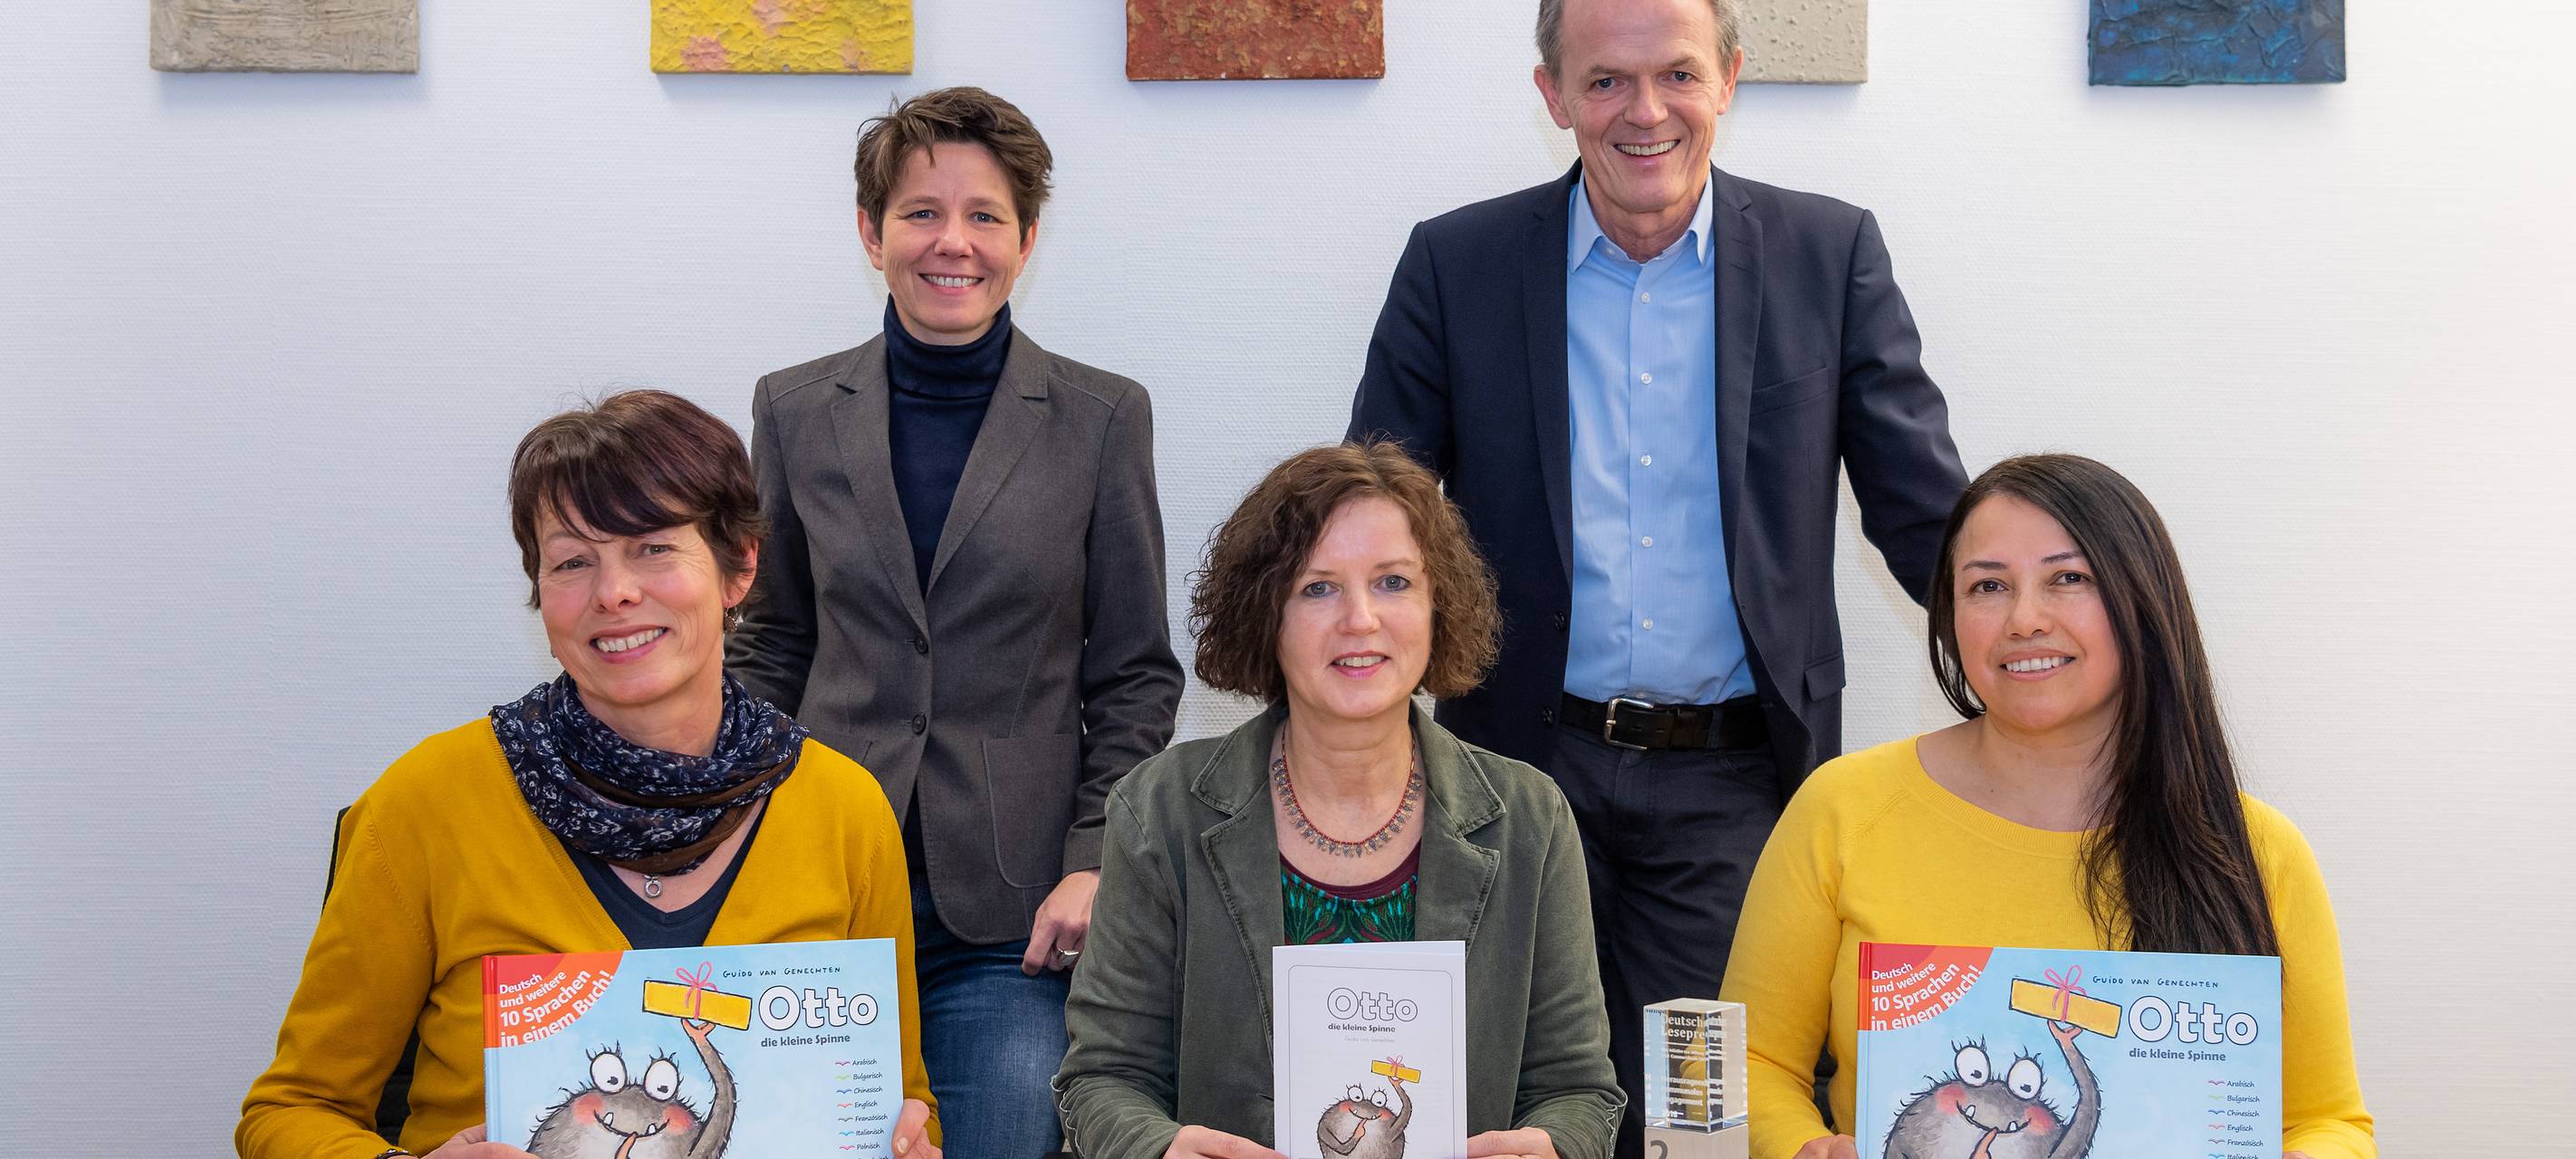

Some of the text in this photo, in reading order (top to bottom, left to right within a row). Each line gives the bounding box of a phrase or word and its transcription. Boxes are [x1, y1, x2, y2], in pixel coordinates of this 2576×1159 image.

[1871, 963, 1913, 980] Deutsch
[1871, 963, 1937, 993] und weitere
[499, 973, 543, 994] Deutsch
[500, 972, 566, 1008] und weitere
[1871, 963, 1960, 1011] 10 Sprachen
[500, 970, 591, 1027] 10 Sprachen
[1870, 964, 1983, 1030] in einem Buch!
[500, 970, 613, 1048] in einem Buch!
[758, 984, 879, 1031] Otto
[1327, 987, 1418, 1022] Otto
[2128, 995, 2258, 1046] Otto
[1328, 1022, 1396, 1033] die kleine Spinne
[760, 1034, 851, 1048] die kleine Spinne
[2129, 1048, 2226, 1061] die kleine Spinne
[852, 1072, 883, 1081] Bulgarisch
[853, 1086, 883, 1094] Chinesisch
[854, 1100, 879, 1109] Englisch
[2226, 1095, 2260, 1104] Bulgarisch
[855, 1113, 889, 1122] Französisch
[2226, 1109, 2260, 1117] Chinesisch
[855, 1127, 885, 1136] Italienisch
[2227, 1124, 2254, 1133] Englisch
[856, 1142, 880, 1150] Polnisch
[2227, 1138, 2264, 1147] Französisch
